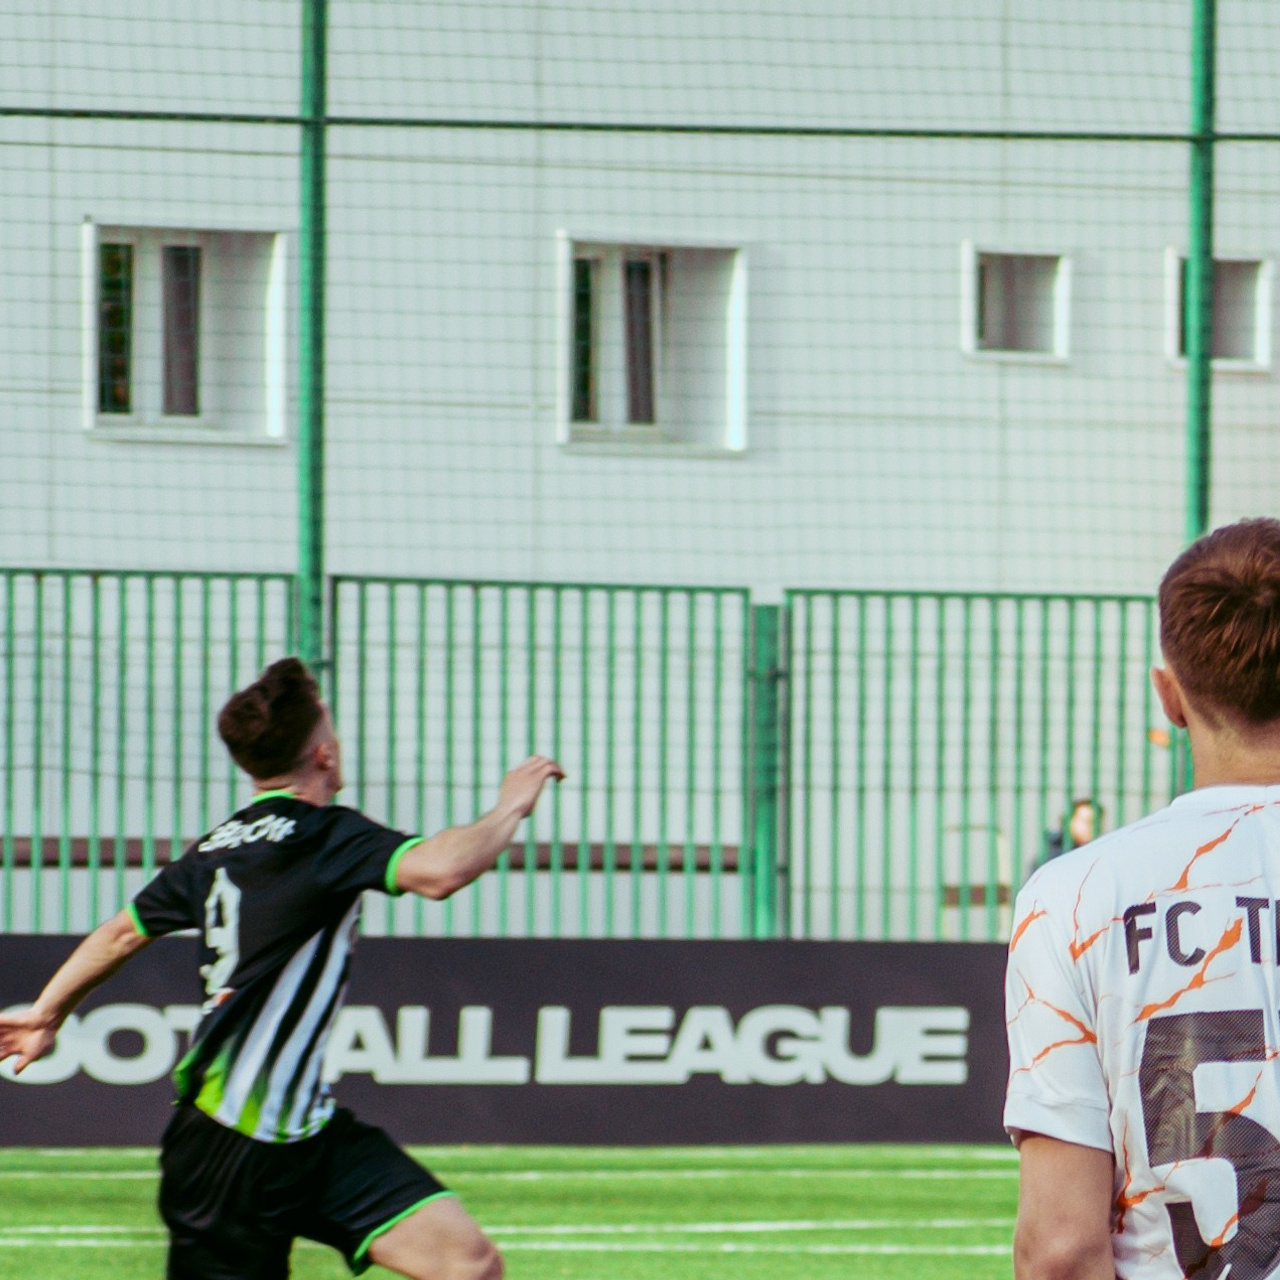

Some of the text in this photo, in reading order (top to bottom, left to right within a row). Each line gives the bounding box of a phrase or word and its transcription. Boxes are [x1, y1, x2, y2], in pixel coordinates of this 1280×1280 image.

[1123, 900, 1206, 975] FC
[0, 1003, 969, 1086] OOALL LEAGUE
